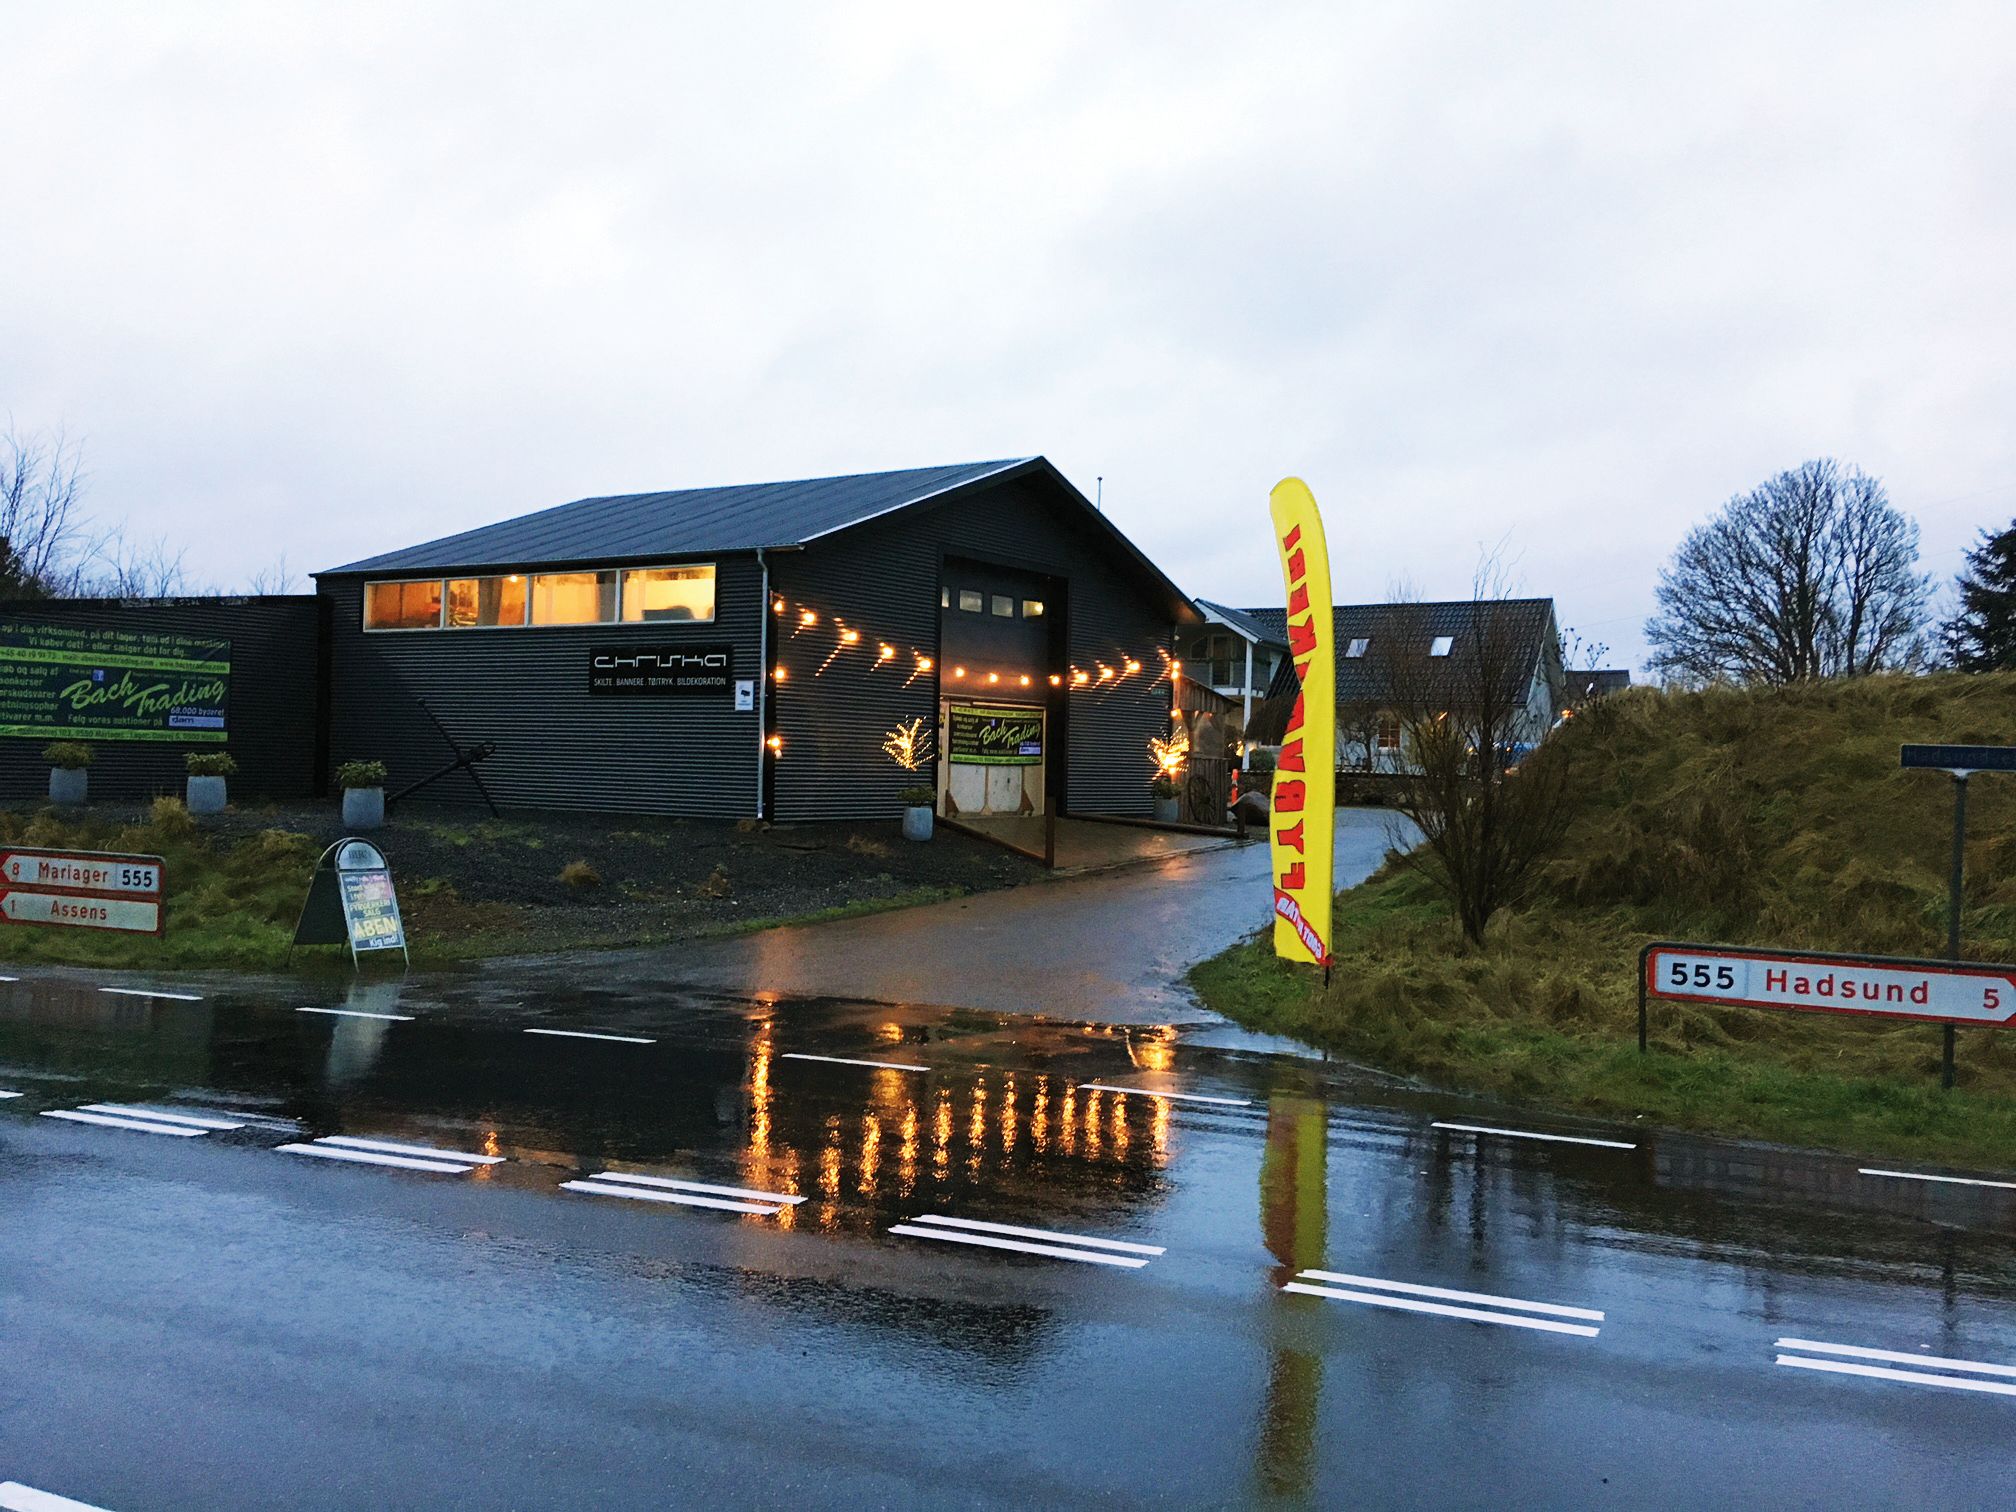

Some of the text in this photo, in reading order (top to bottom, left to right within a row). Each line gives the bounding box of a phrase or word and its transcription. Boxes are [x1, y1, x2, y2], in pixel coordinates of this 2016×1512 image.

[28, 637, 38, 646] Vi
[59, 670, 228, 717] Bach Trading
[593, 677, 613, 687] SKILTE
[616, 677, 644, 687] BANNERE
[677, 676, 726, 686] BILDEKORATION
[88, 715, 111, 725] vores
[978, 718, 1008, 746] Bach
[12, 861, 153, 888] 8 Mariager 555
[50, 900, 108, 921] Assens
[1670, 962, 2000, 1010] 555 Hadsund 5
